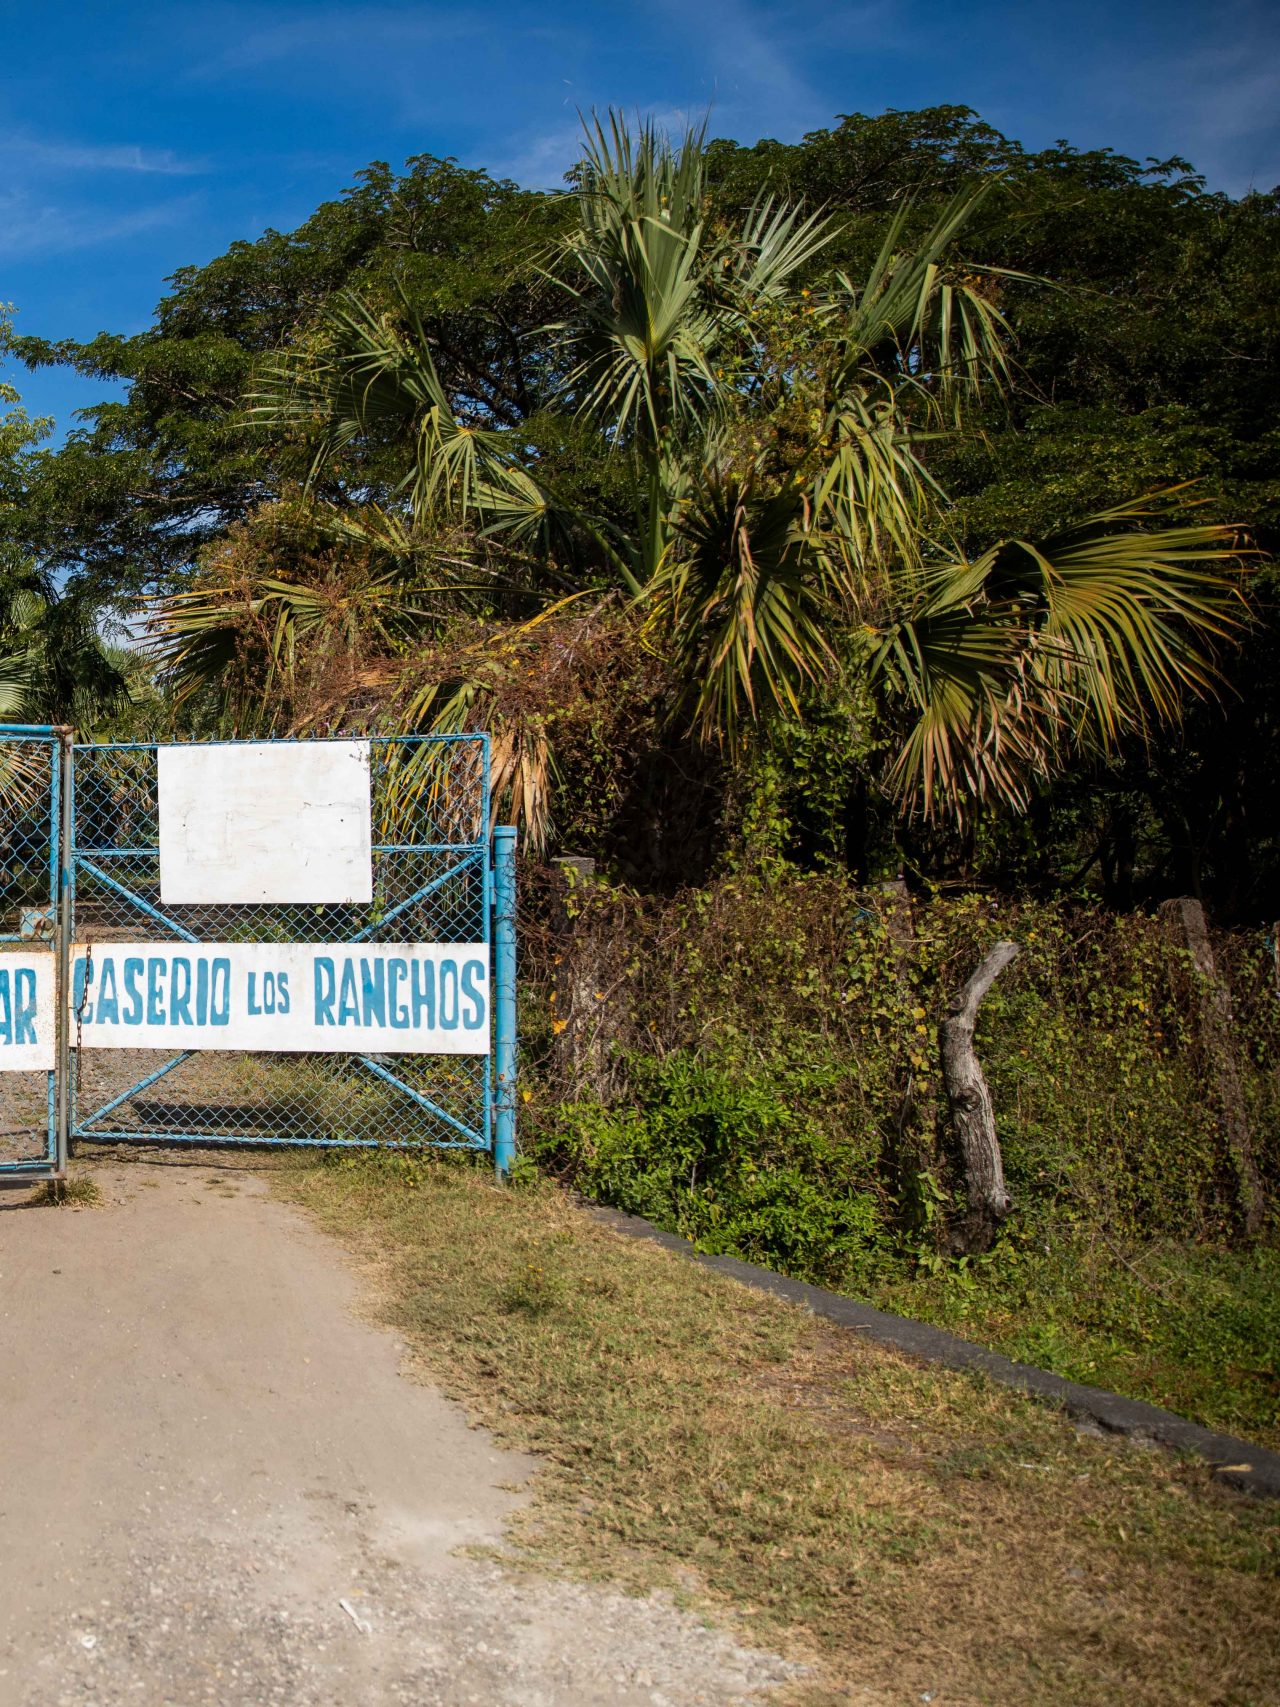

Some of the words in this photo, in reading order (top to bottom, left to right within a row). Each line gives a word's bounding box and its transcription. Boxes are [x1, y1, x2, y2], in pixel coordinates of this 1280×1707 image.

[73, 957, 231, 1025] CASERIO
[247, 971, 290, 1016] LOS
[315, 957, 485, 1029] RANCHOS
